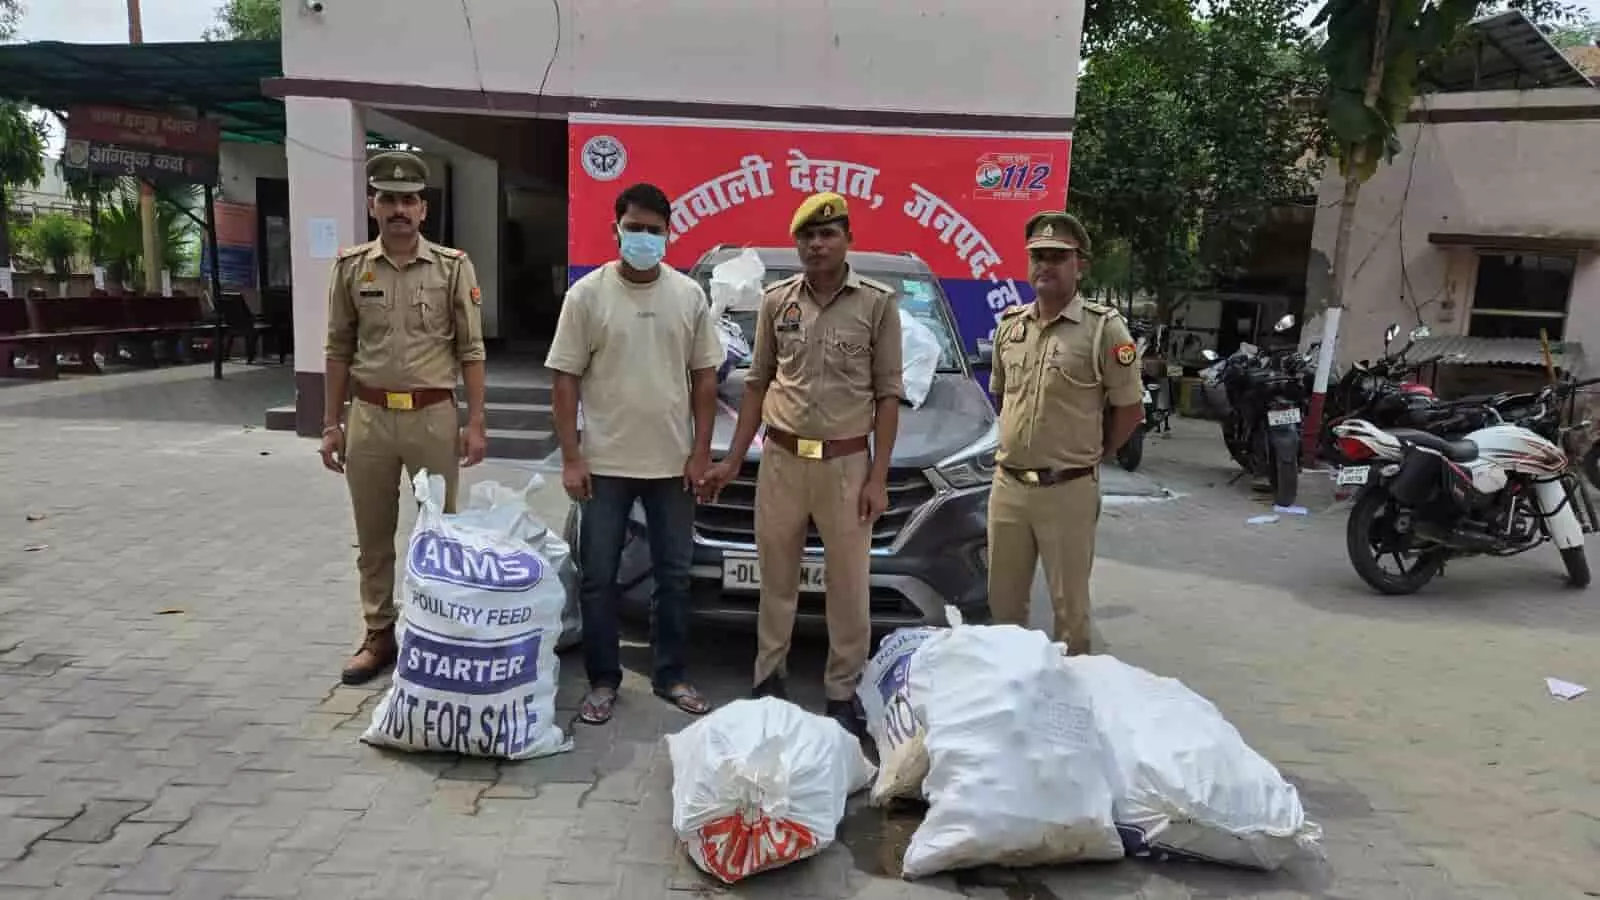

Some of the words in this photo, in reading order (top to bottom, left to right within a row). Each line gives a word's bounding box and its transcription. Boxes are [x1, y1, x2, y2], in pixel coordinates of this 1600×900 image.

[669, 155, 773, 243] तवाली
[786, 149, 884, 209] देहात,
[1003, 164, 1051, 190] 112
[421, 538, 529, 581] ALMS
[411, 590, 482, 625] POULTRY
[486, 607, 532, 626] FEED
[408, 647, 525, 682] STARTER
[379, 688, 418, 741] NOT
[424, 701, 472, 752] FOR
[478, 694, 538, 756] SALE
[885, 698, 921, 751] NO
